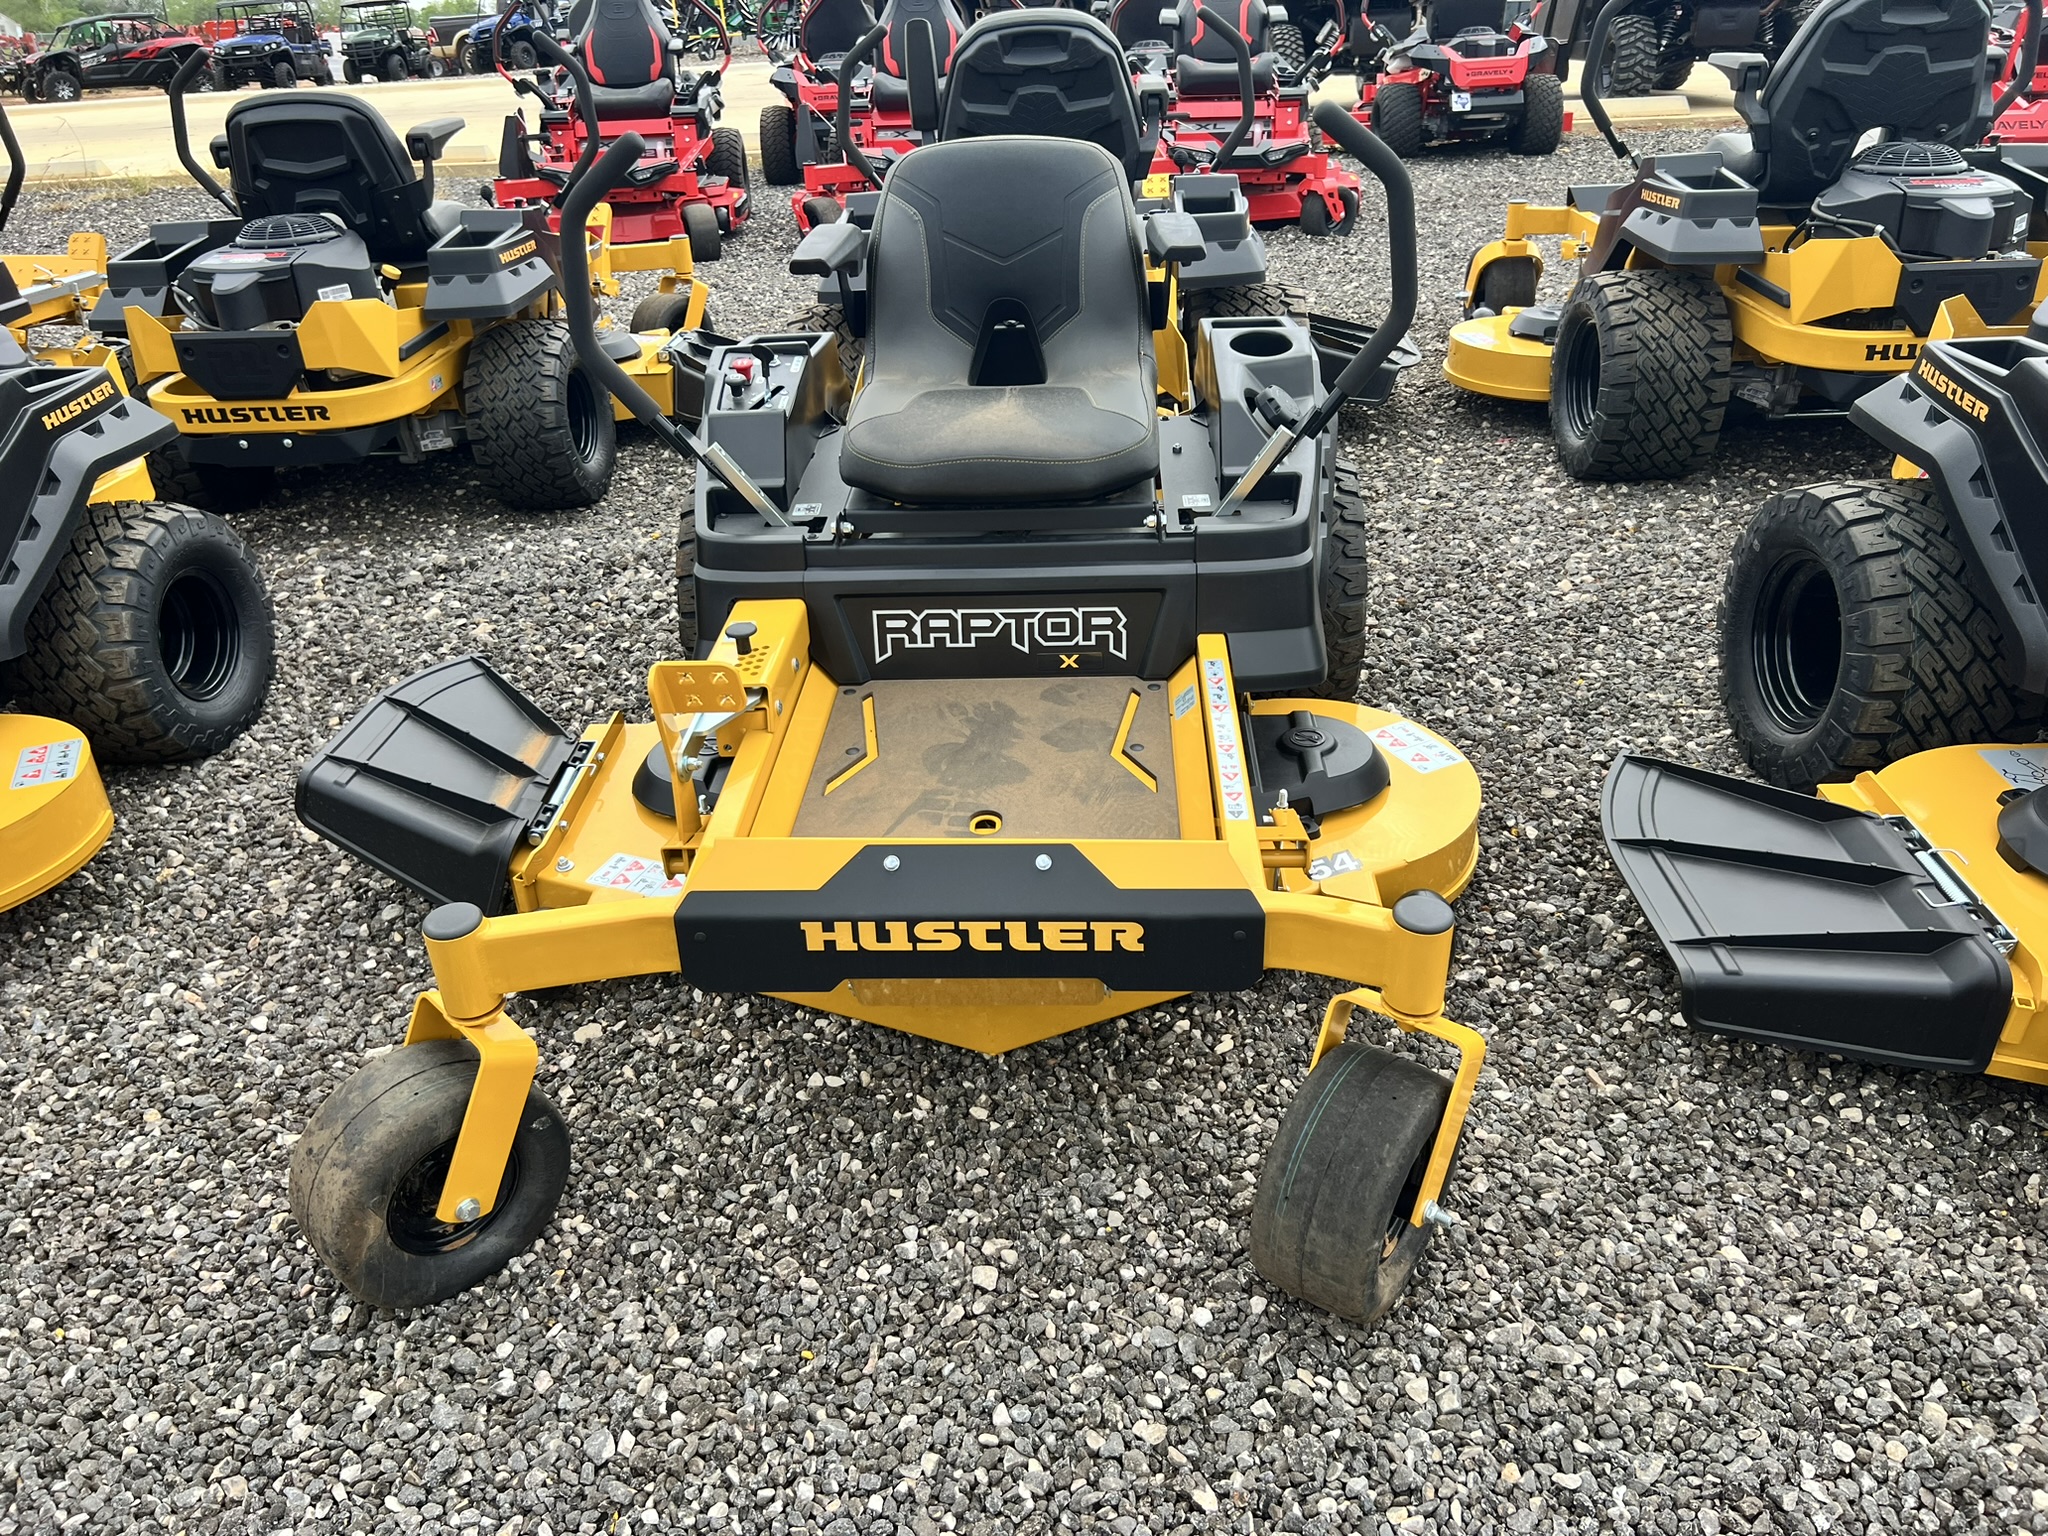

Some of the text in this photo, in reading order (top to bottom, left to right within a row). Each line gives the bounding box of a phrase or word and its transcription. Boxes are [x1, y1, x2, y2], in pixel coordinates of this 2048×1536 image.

[1470, 69, 1509, 77] GRAVELY
[1640, 188, 1681, 210] HUSTLER
[498, 239, 537, 265] HUSTLER
[1864, 343, 1925, 361] HU
[1917, 358, 1990, 423] HUSTLER
[41, 380, 115, 431] HUSTLER
[180, 405, 331, 425] HUSTLER
[872, 606, 1128, 665] RAPTOR
[1058, 653, 1080, 669] X
[1308, 851, 1360, 881] 54
[799, 920, 1145, 952] HUSTLER
